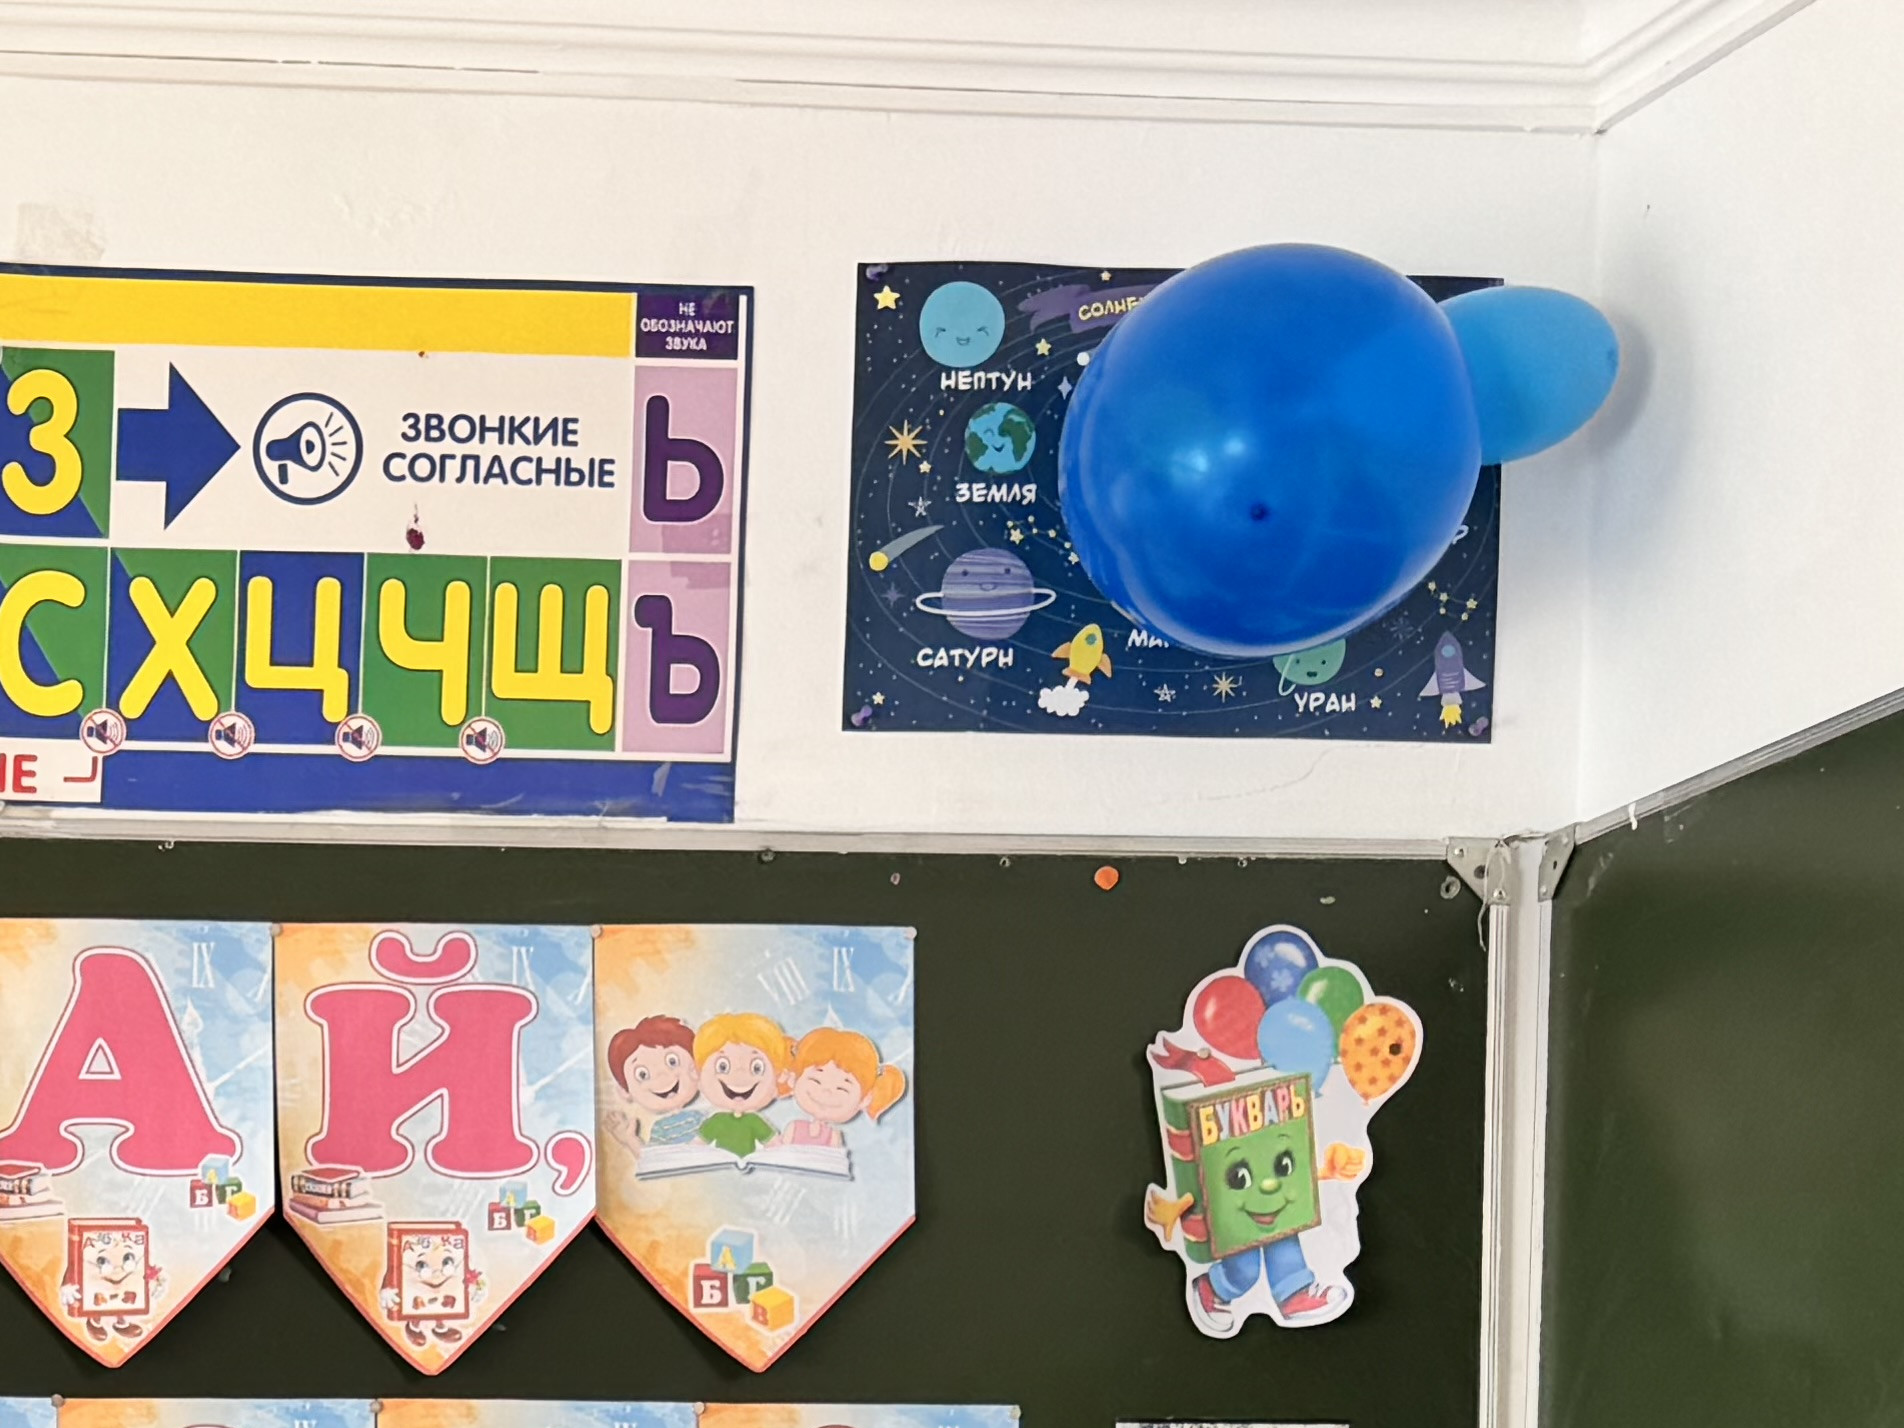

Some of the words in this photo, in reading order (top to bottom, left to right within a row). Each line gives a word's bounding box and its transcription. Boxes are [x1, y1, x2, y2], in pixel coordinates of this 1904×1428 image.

[678, 302, 696, 316] НЕ
[640, 318, 734, 334] ОБОЗНАЧАЮТ
[665, 336, 707, 351] ЗВУКА
[940, 370, 1033, 392] НЕПТУН
[400, 412, 580, 449] ЗВОНКИЕ
[644, 396, 725, 522] Ь
[382, 454, 616, 490] СОГЛАСНЫЕ
[955, 481, 1037, 505] ЗЕМЛЯ
[637, 595, 720, 724] Ъ
[916, 646, 1014, 668] САТУРН
[1294, 692, 1357, 713] УРАН
[1198, 1083, 1306, 1146] БУКВАРЬ
